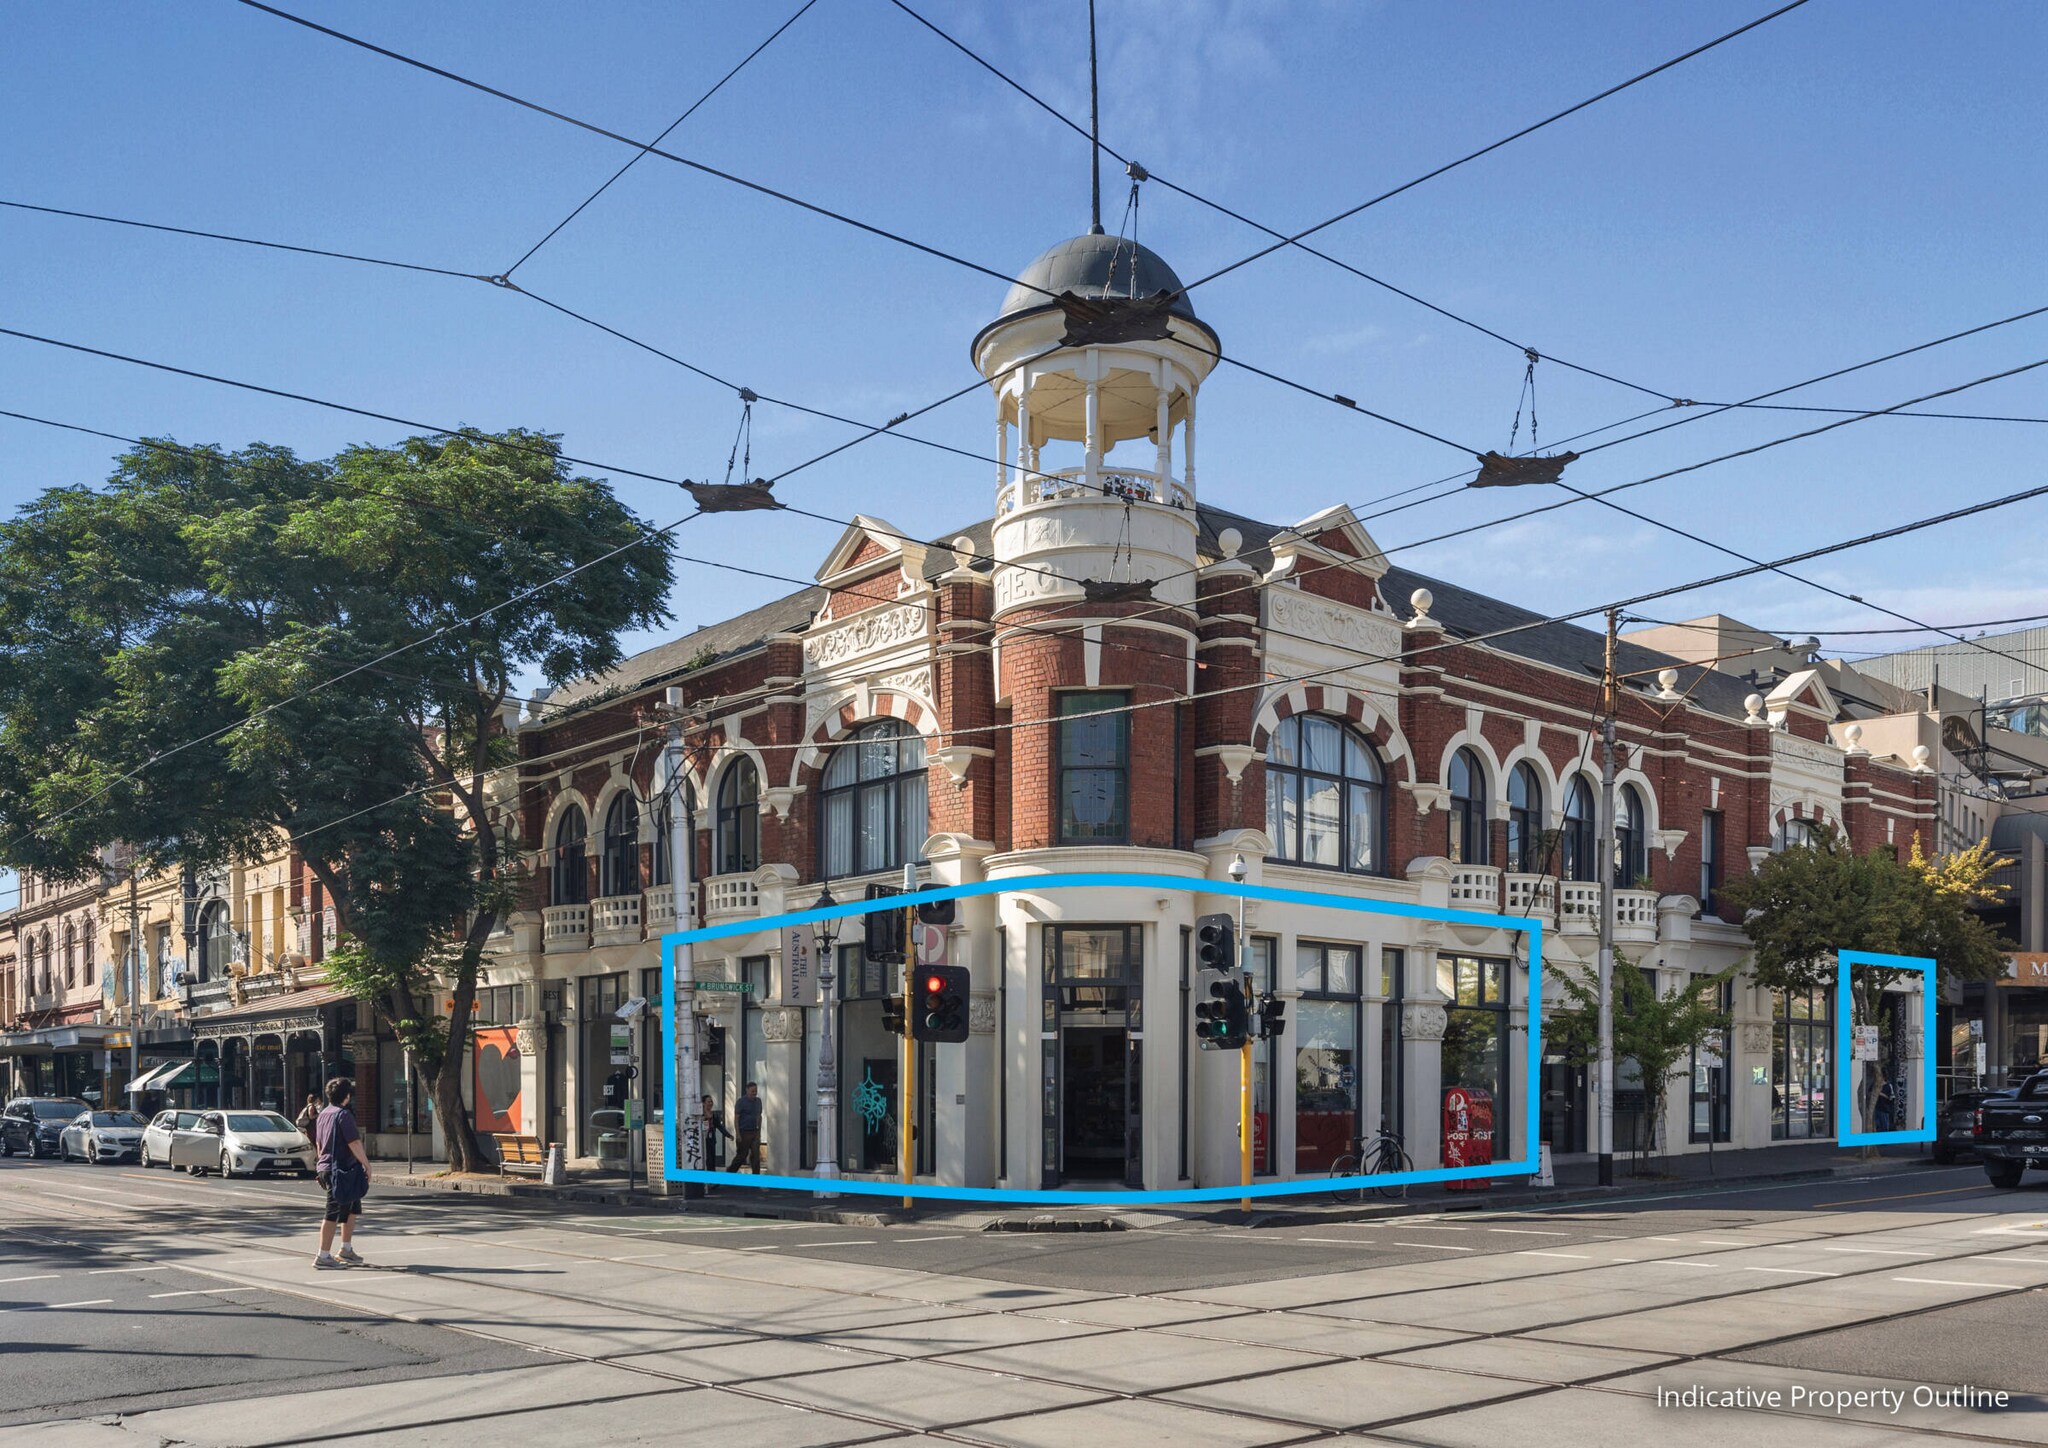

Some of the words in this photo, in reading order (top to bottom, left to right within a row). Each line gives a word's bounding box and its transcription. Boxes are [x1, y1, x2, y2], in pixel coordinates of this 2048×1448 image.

[792, 930, 800, 999] AUSTRALIAN
[706, 983, 743, 992] BRUNSWICK
[745, 984, 753, 992] ST
[544, 990, 560, 1000] BEST
[603, 1084, 614, 1096] BEST
[1447, 1132, 1468, 1141] POST
